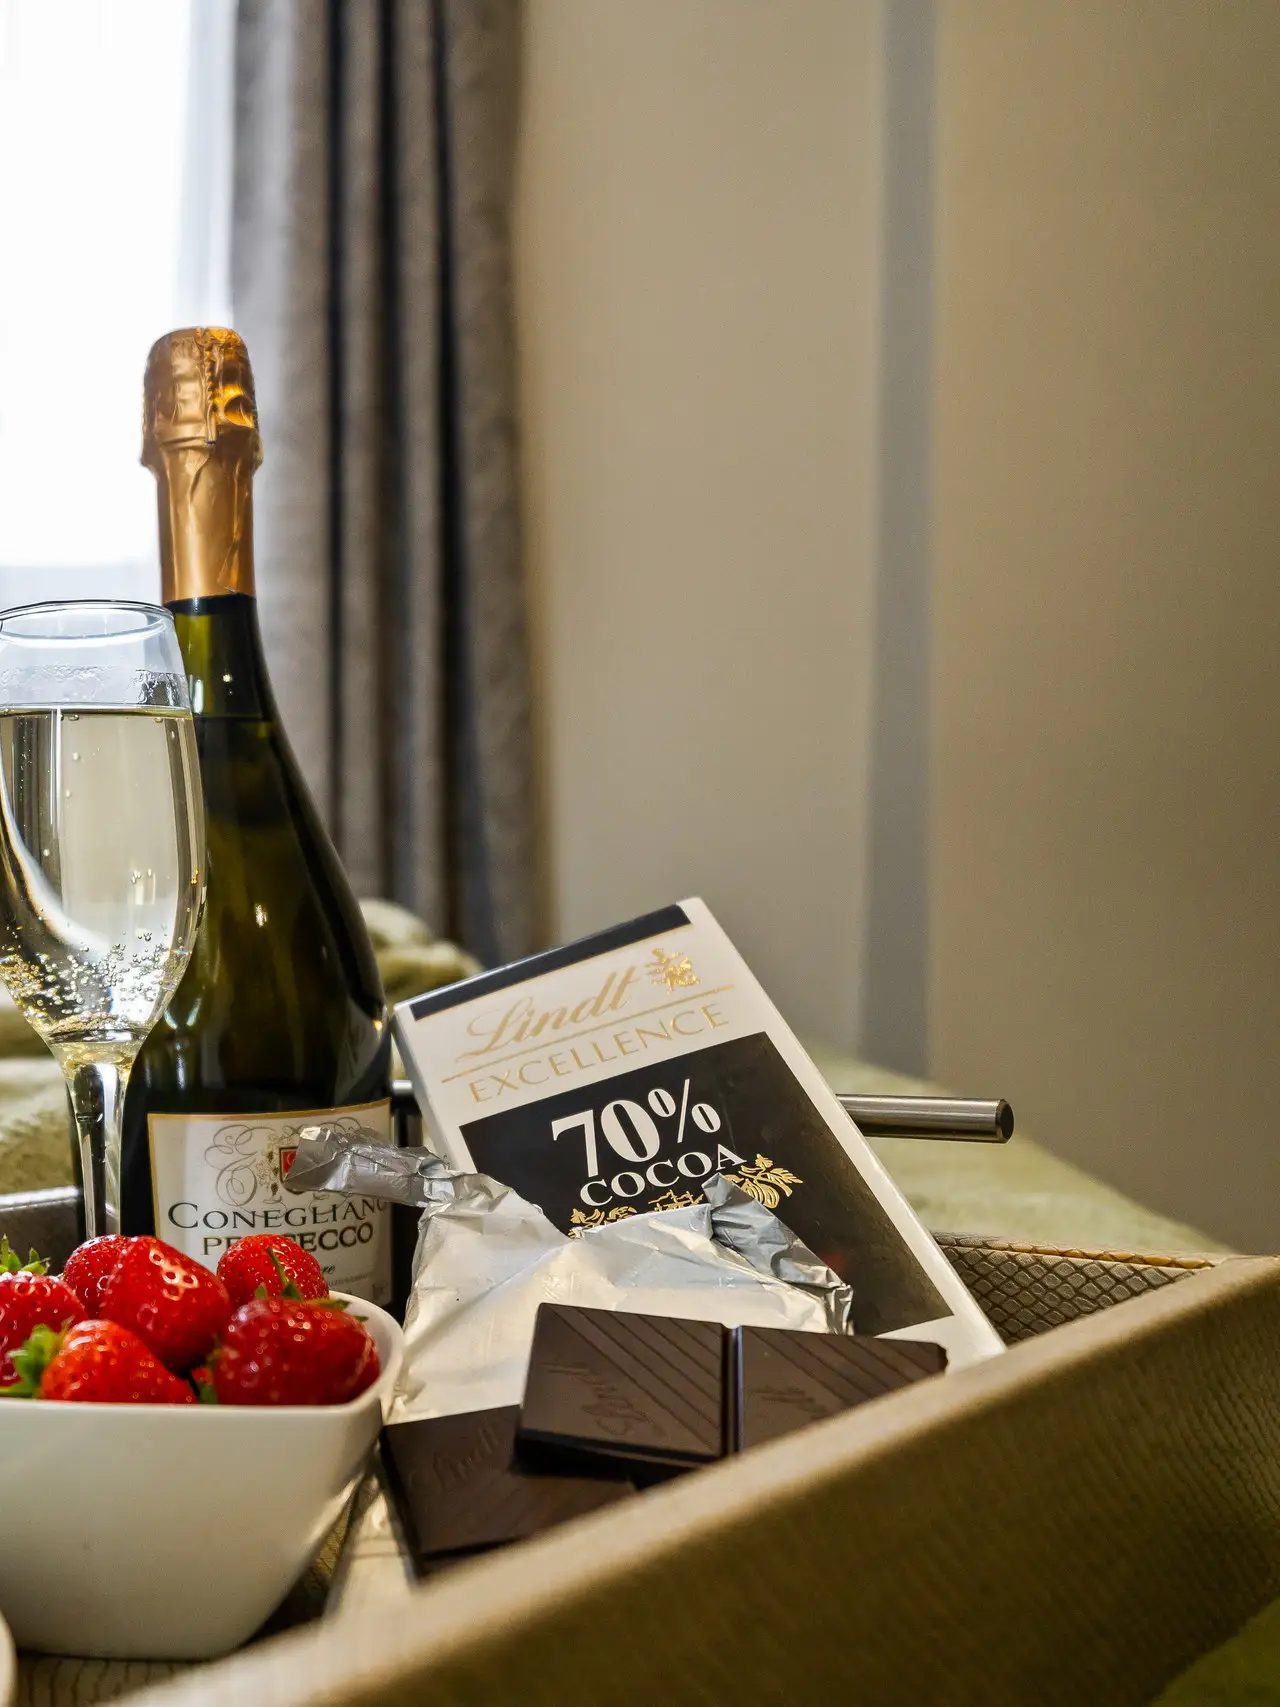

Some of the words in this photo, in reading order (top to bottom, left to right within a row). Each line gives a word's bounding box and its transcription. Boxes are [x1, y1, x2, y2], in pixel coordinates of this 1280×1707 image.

[455, 966, 641, 1062] Lindt
[469, 1003, 729, 1102] EXCELLENCE
[551, 1078, 721, 1177] 70%
[580, 1144, 747, 1206] COCOA
[200, 1222, 374, 1256] PECCO
